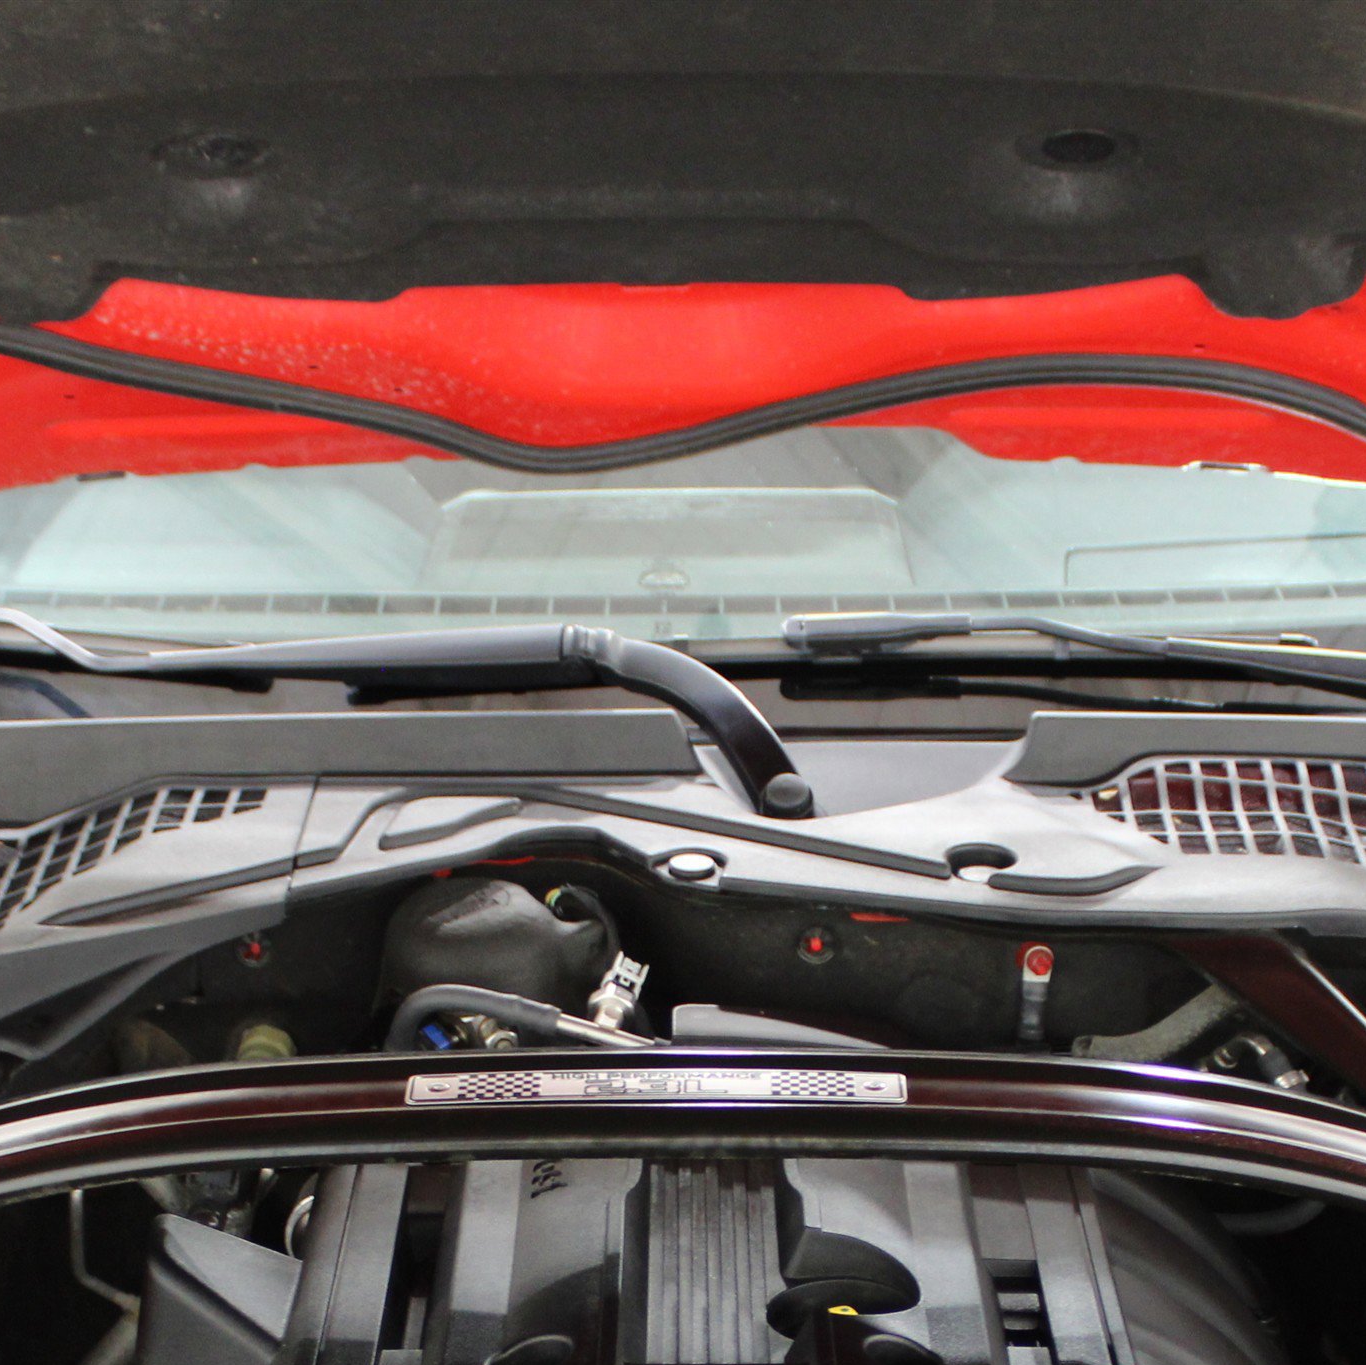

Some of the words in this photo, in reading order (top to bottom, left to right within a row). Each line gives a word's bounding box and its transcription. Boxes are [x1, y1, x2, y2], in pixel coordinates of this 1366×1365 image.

[551, 1071, 600, 1080] HIGH
[606, 1071, 762, 1080] PERFORMANCE
[583, 1078, 729, 1095] 2.3L
